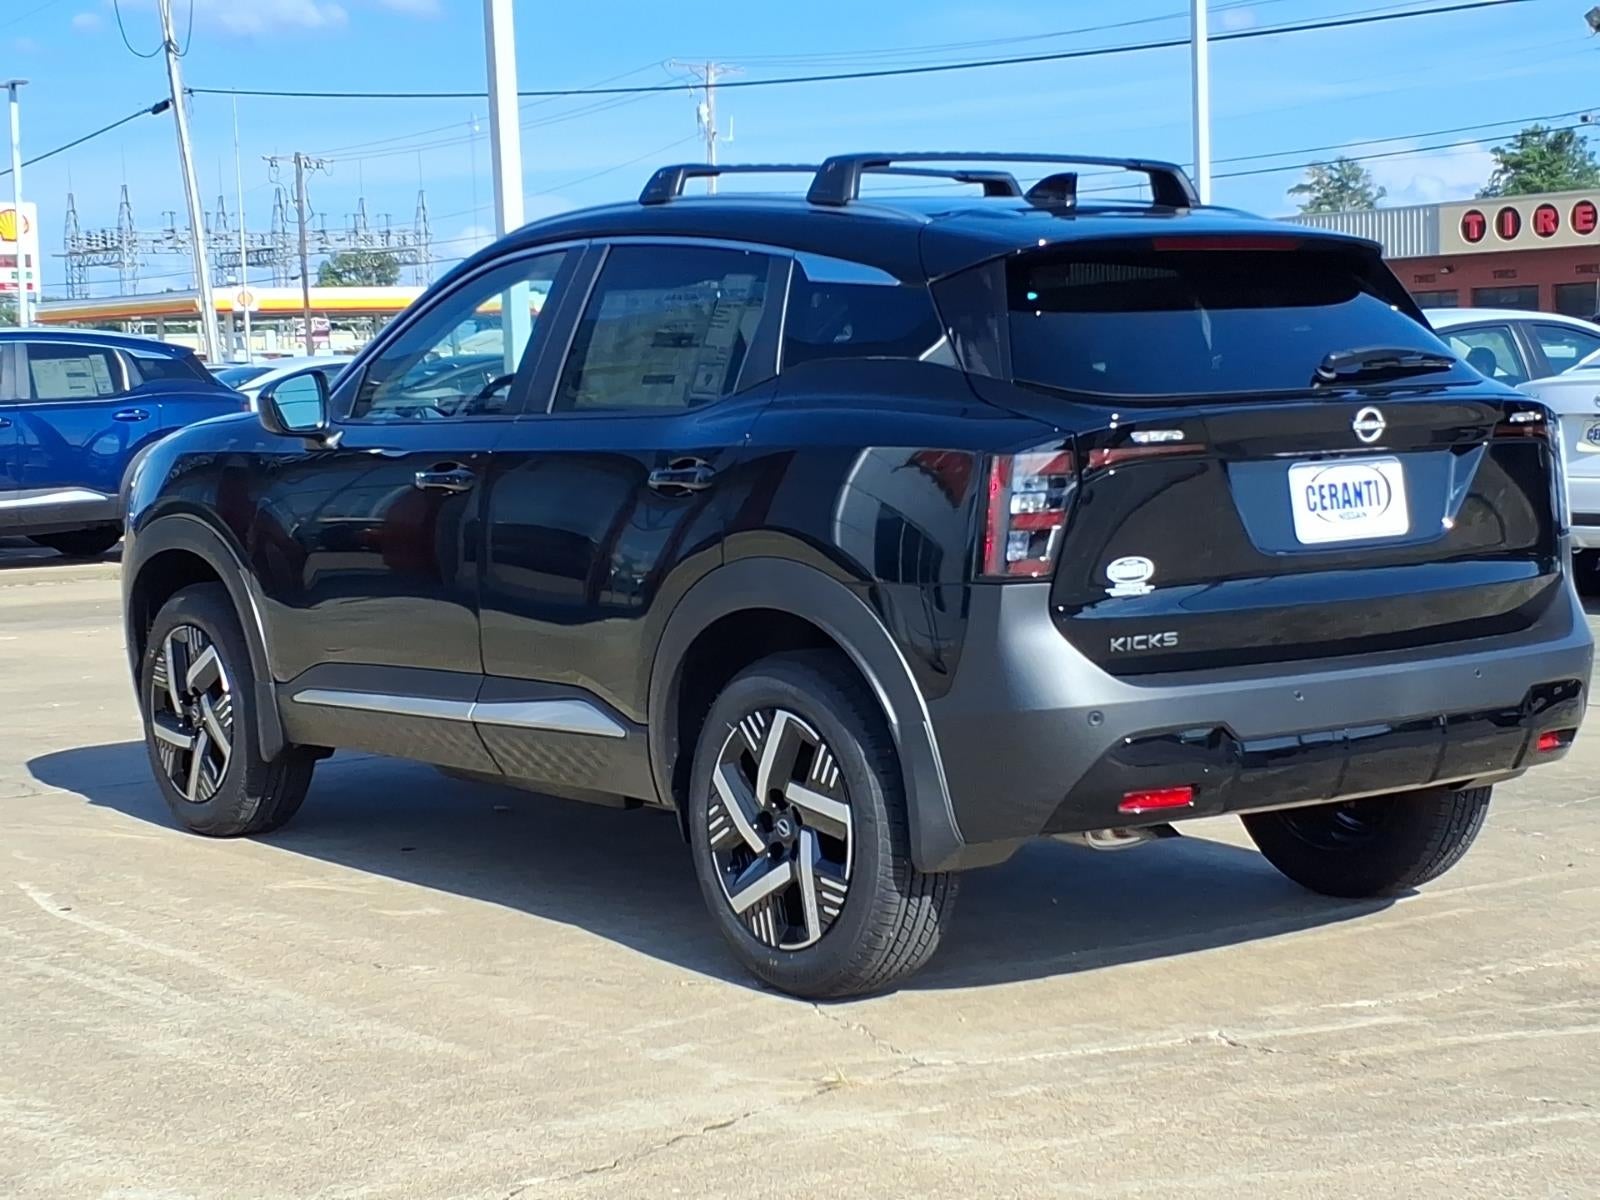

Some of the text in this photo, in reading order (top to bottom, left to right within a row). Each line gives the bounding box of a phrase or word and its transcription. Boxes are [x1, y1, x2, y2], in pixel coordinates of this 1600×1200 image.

[1464, 205, 1594, 240] TIRE
[1305, 480, 1381, 512] CERANTI
[1110, 632, 1178, 652] KICKS
